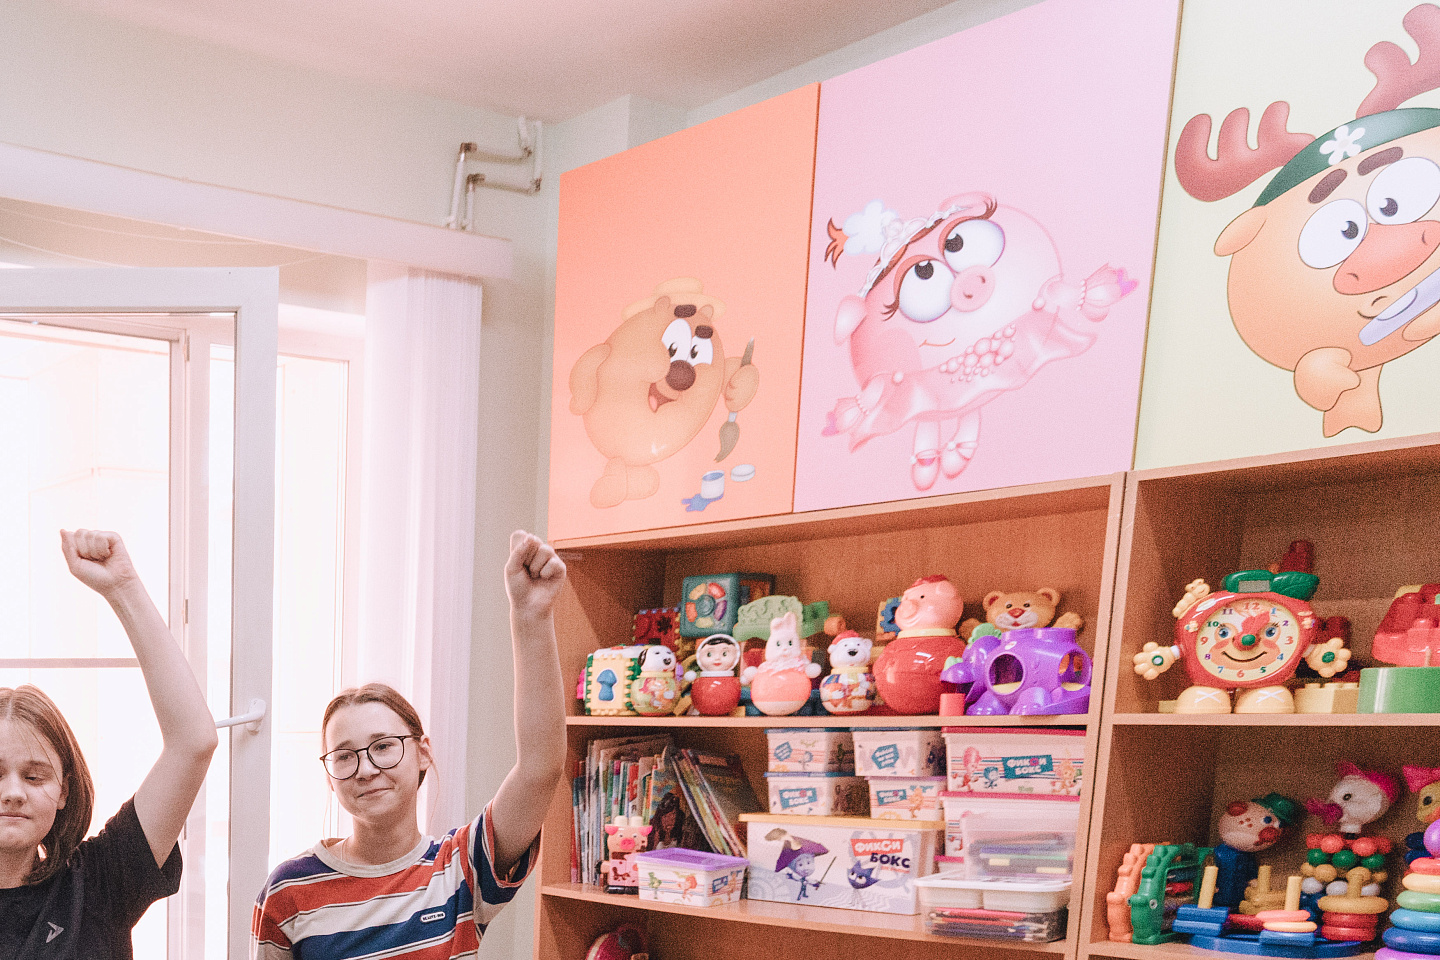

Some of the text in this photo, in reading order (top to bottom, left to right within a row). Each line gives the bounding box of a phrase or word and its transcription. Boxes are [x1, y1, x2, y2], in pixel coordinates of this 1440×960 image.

[1200, 636, 1209, 645] 9
[1284, 636, 1294, 645] 3
[854, 840, 901, 854] ФИКСИ
[870, 852, 911, 869] БОКС
